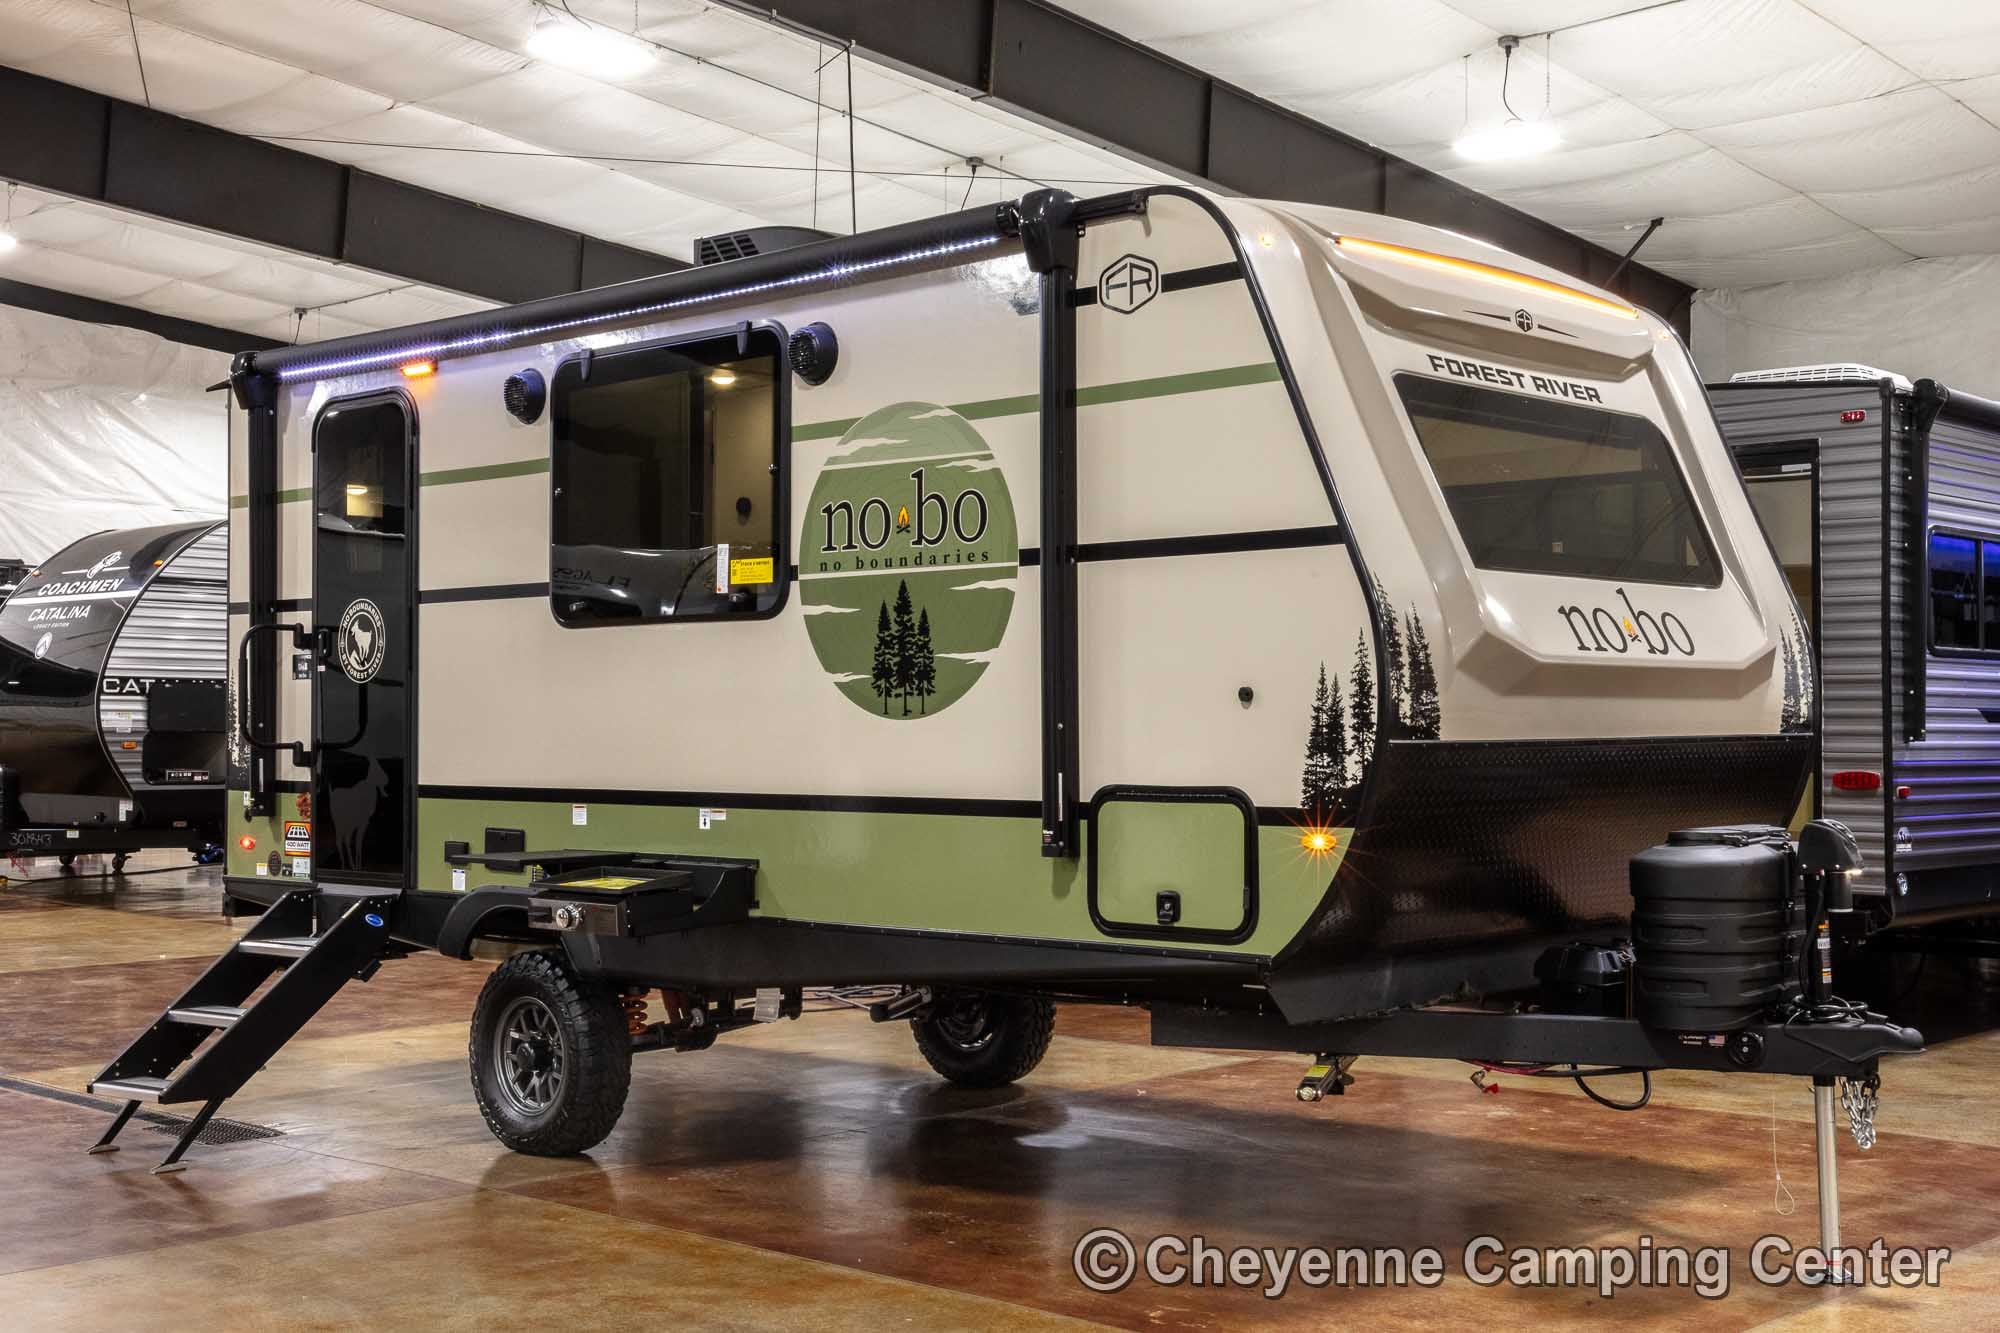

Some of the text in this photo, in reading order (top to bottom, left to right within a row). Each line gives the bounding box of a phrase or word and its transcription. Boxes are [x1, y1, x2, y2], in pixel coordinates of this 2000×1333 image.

[1426, 353, 1604, 404] FOREST RIVER
[819, 550, 991, 572] no boundaries
[37, 578, 125, 596] COACHMEN
[28, 605, 92, 622] CATALINA
